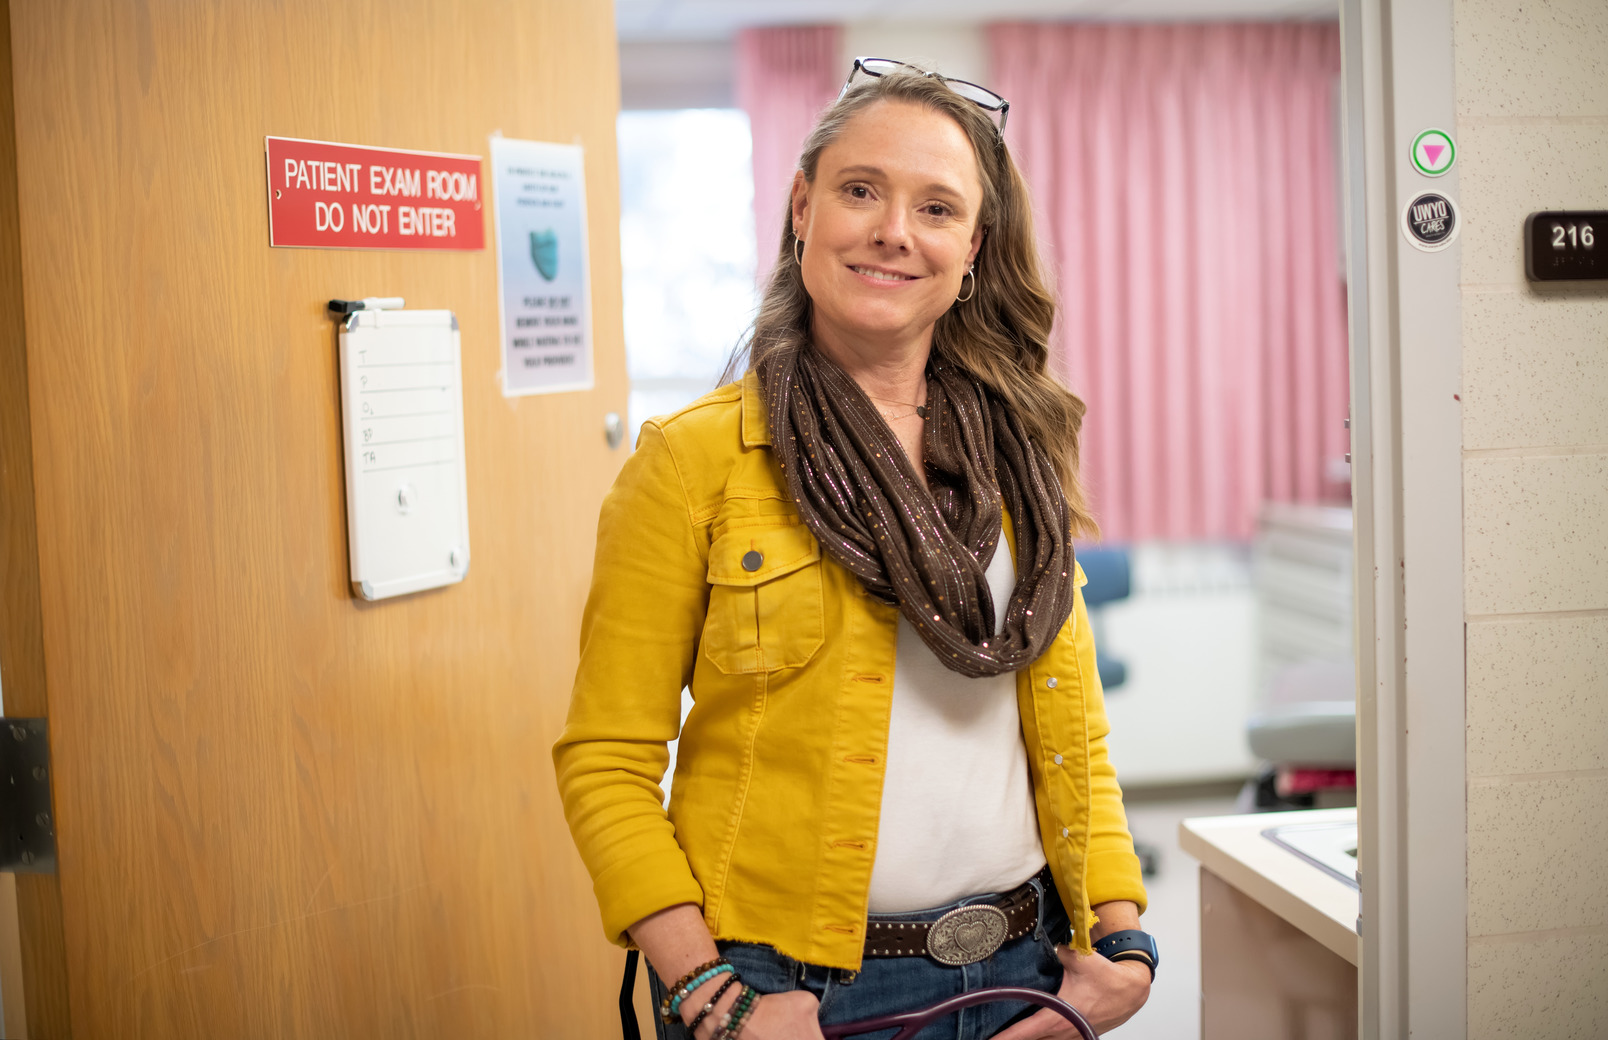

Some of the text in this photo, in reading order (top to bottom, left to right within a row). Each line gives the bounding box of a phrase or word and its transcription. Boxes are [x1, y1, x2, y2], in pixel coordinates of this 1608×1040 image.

[285, 158, 362, 193] PATIENT
[370, 165, 421, 198] EXAM
[426, 170, 478, 202] ROOM
[315, 201, 456, 237] DO NOT ENTER
[1413, 200, 1447, 222] UWYO
[1420, 219, 1445, 234] CARES
[1552, 225, 1594, 247] 216
